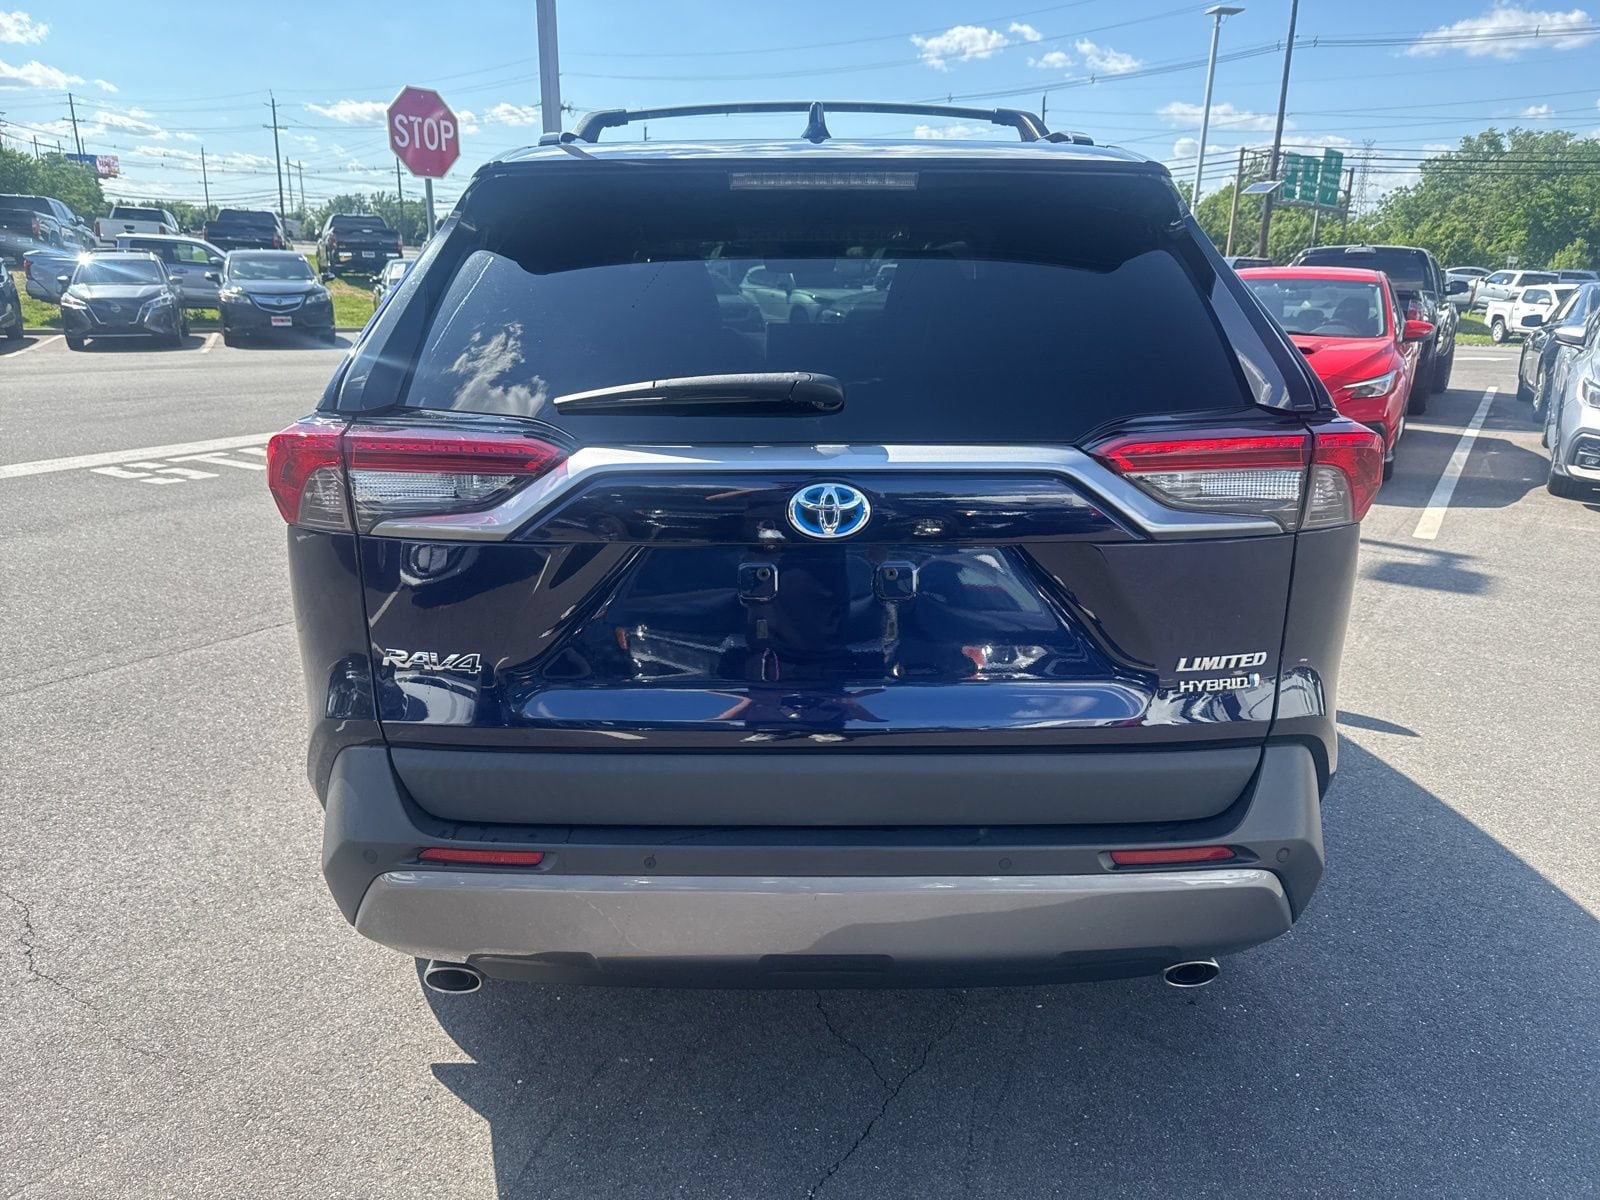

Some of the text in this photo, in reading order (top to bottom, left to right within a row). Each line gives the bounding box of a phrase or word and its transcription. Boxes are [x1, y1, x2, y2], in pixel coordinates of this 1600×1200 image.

[394, 113, 454, 152] STOP
[382, 648, 482, 674] RAV4
[1175, 651, 1267, 672] LIMITED
[1180, 676, 1250, 693] HYBRID
